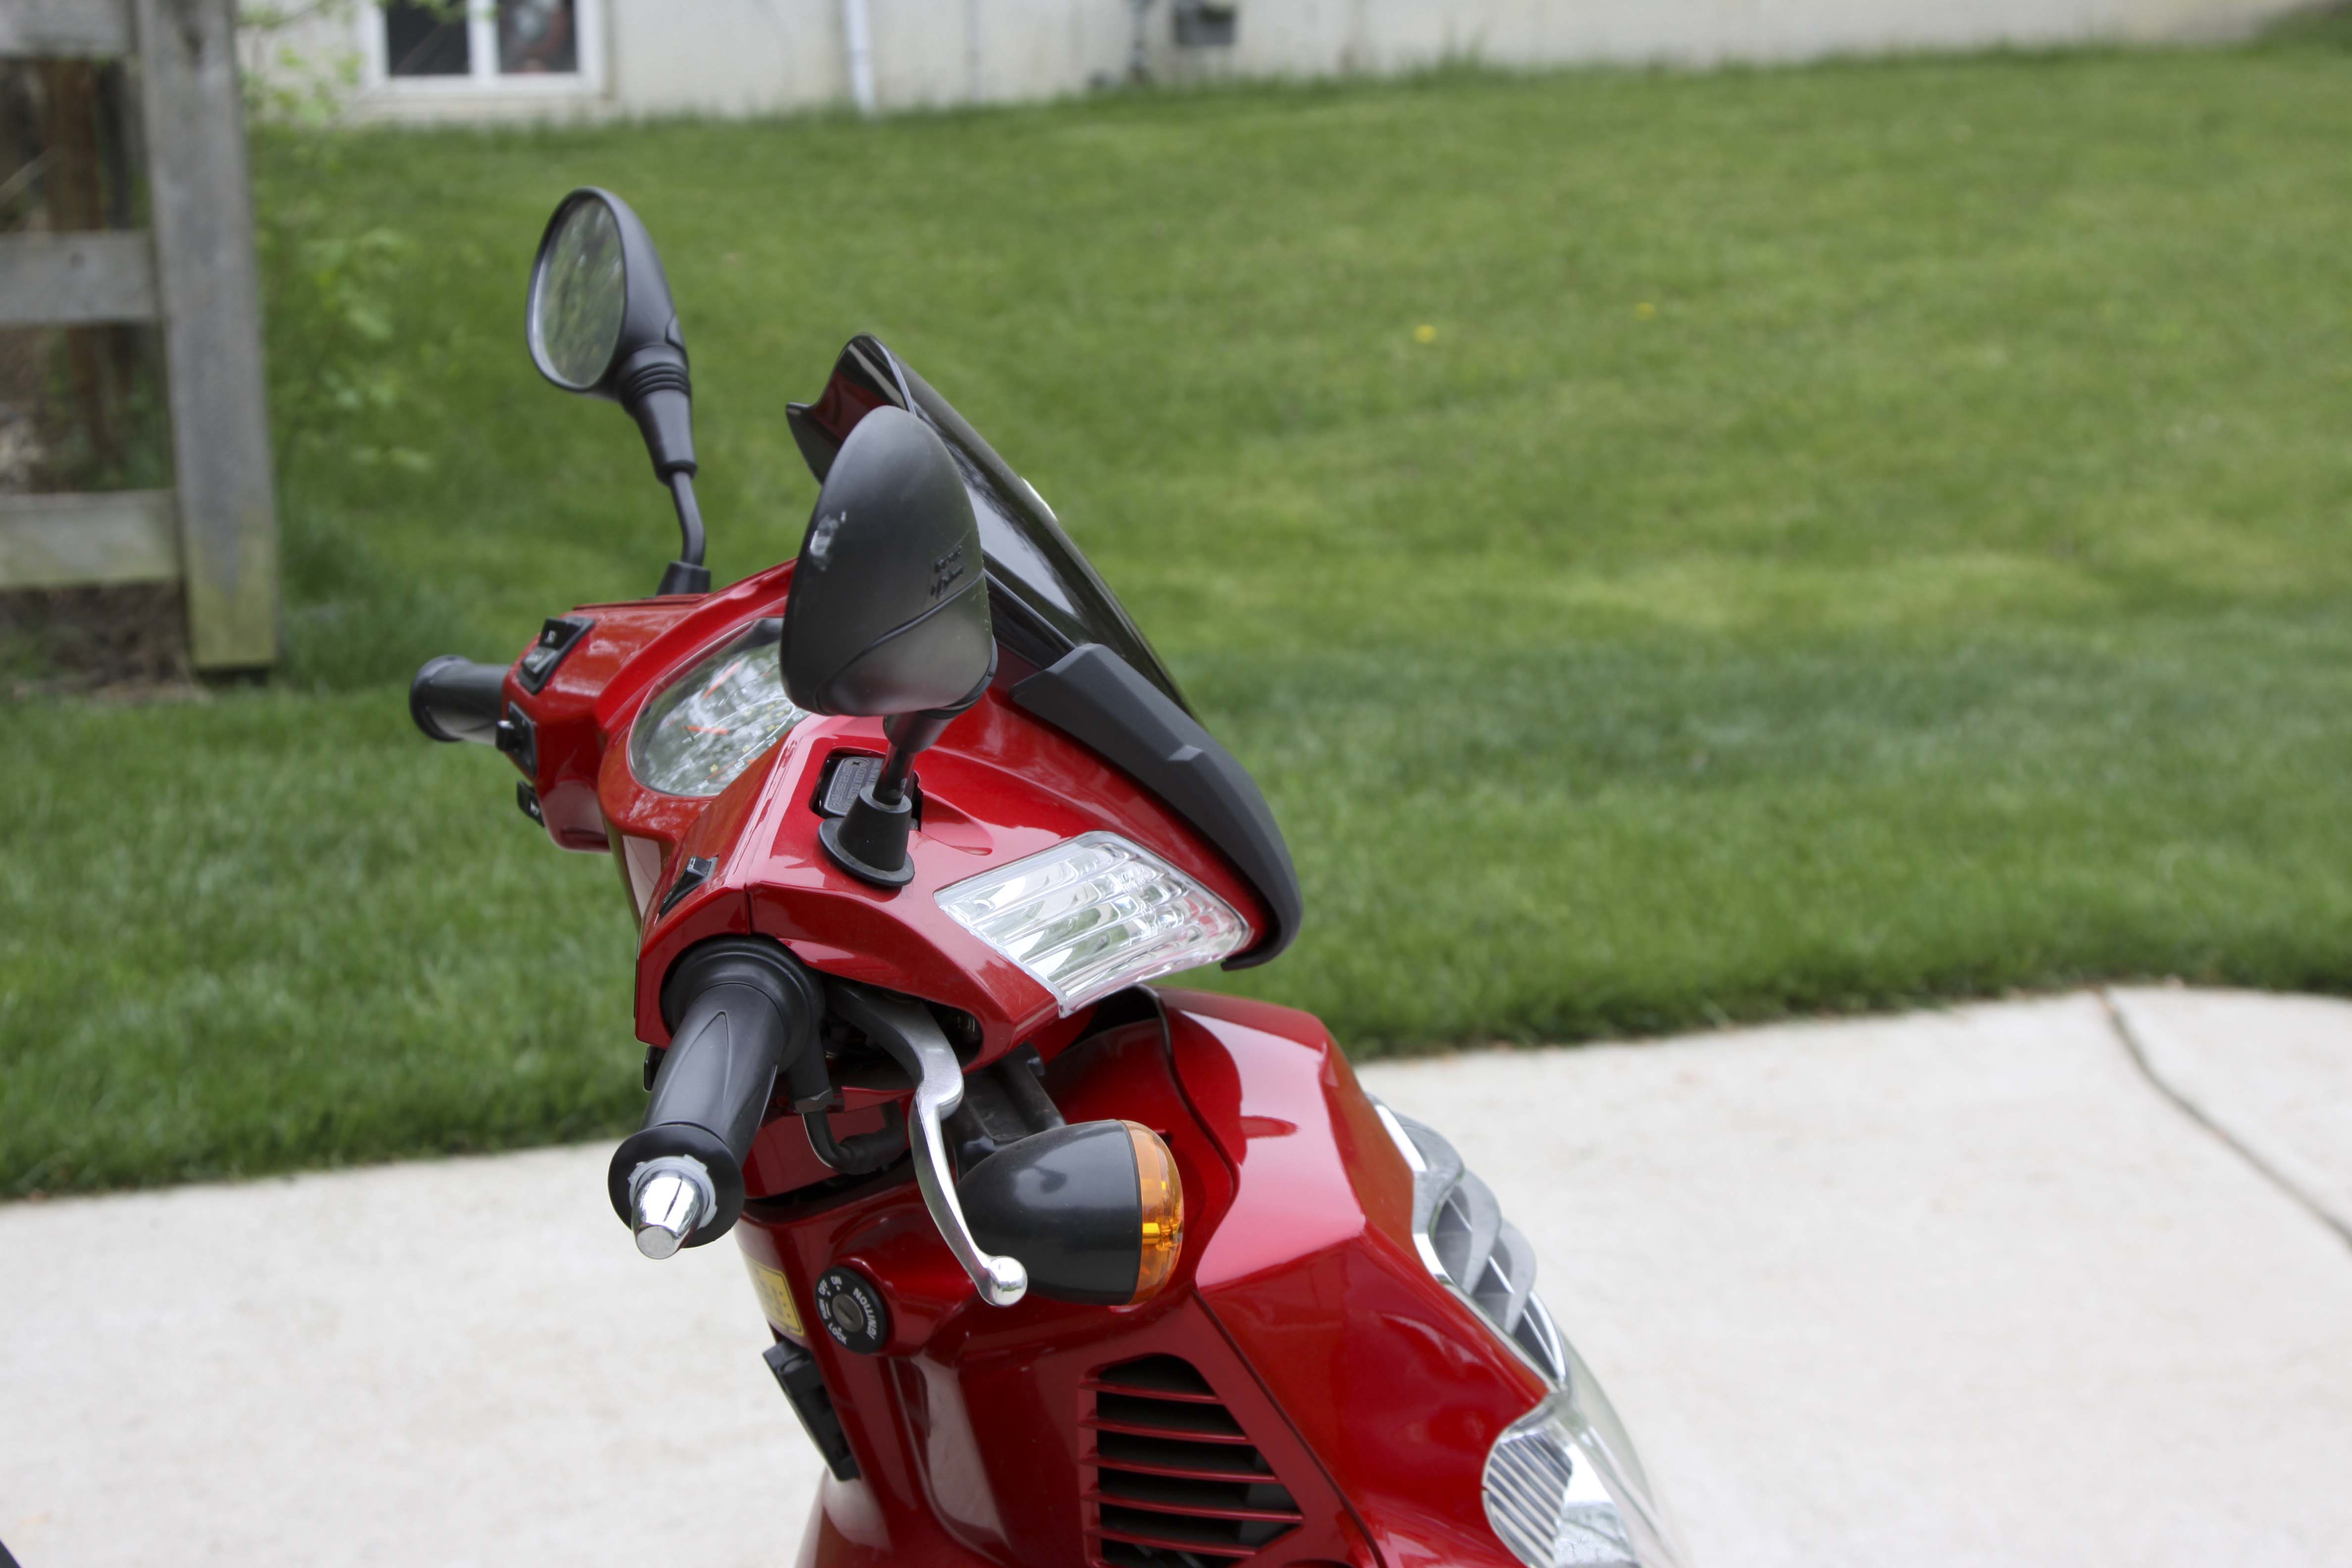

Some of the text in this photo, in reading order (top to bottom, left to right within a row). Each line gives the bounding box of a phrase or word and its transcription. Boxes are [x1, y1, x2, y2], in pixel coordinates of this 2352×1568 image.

[830, 1275, 842, 1285] ON
[852, 1287, 877, 1340] IGNITION
[828, 1322, 847, 1345] LOCK
